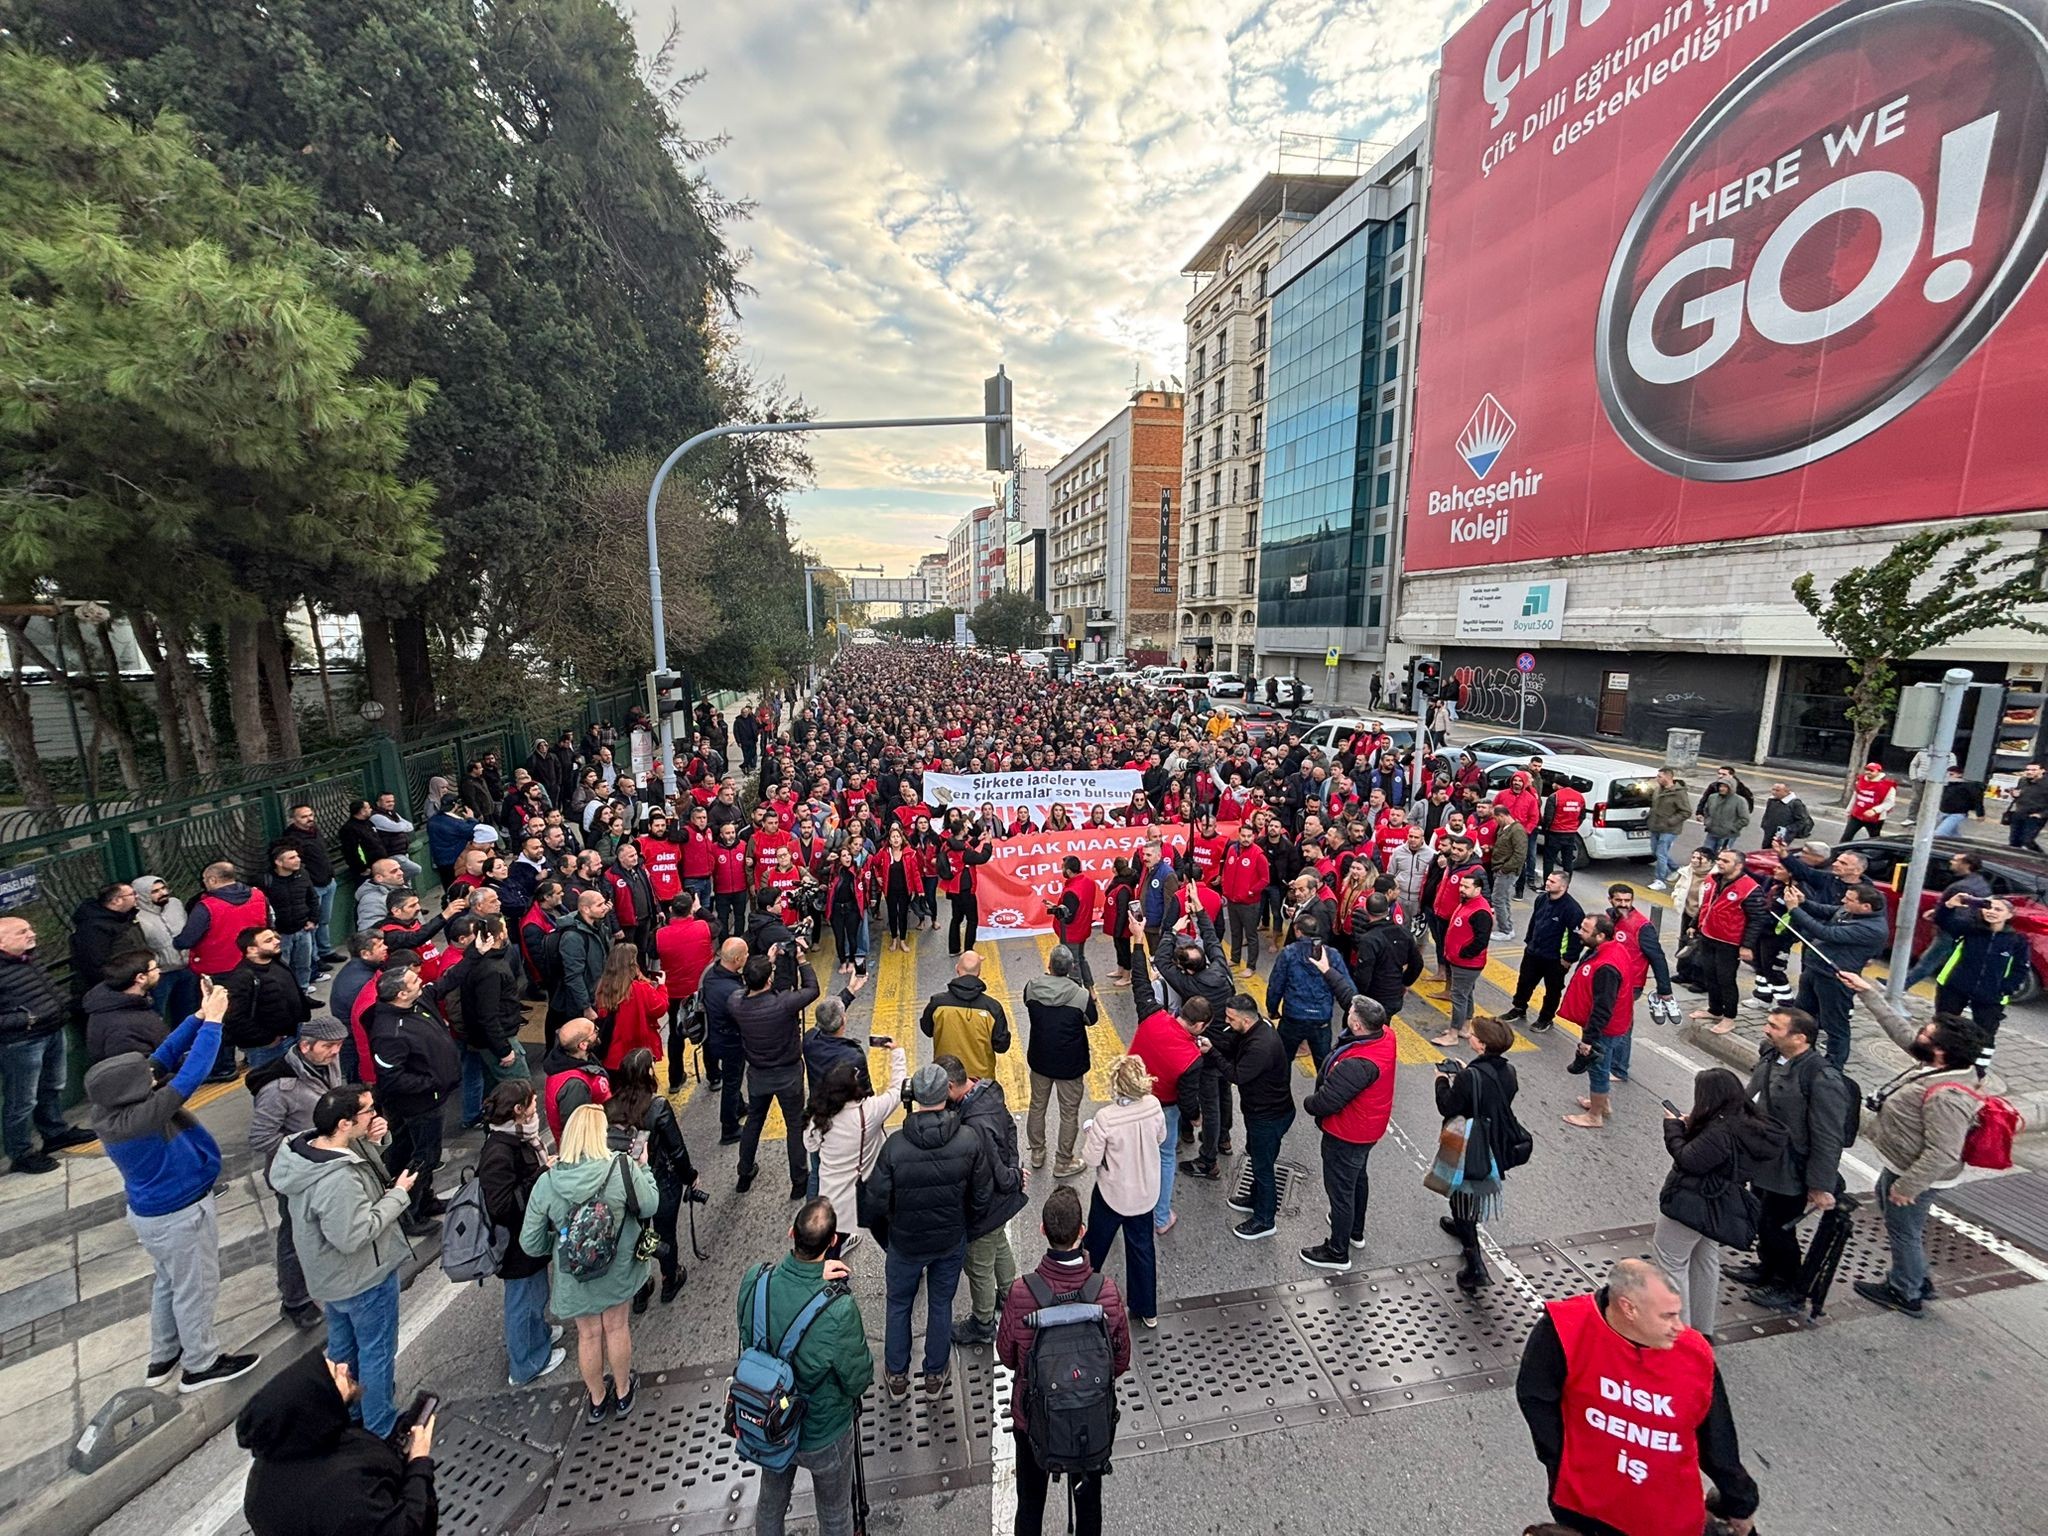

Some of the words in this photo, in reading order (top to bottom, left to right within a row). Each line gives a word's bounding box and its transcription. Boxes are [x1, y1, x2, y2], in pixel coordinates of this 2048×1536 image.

[1481, 131, 1517, 179] Çift
[1522, 87, 1568, 143] Dilli
[1573, 0, 1693, 105] Eğitimin
[1688, 150, 1802, 234] HERE
[1822, 95, 1910, 167] WE
[1627, 110, 2000, 385] GO!
[1231, 415, 1240, 457] INN
[1161, 490, 1171, 526] MAY
[1428, 468, 1543, 515] Bahçeşehir
[1450, 509, 1509, 545] Koleji
[1159, 536, 1169, 584] PARK
[1513, 619, 1554, 631] Boyut360
[972, 776, 1023, 790] Şirkete
[1080, 778, 1096, 786] ve
[974, 787, 1052, 802] çıkarmalar
[1055, 788, 1080, 797] son
[1084, 787, 1135, 798] bulsun
[652, 863, 677, 871] GENEL
[656, 852, 676, 861] DİSK
[762, 847, 777, 855] DİS
[987, 841, 1061, 863] IPLAK
[1066, 836, 1148, 852] MAAŞA
[1015, 858, 1097, 881] ÇIPLK
[1599, 1376, 1676, 1418] DİSK
[1585, 1407, 1683, 1452] GENEL
[1616, 1448, 1649, 1485] İŞ
